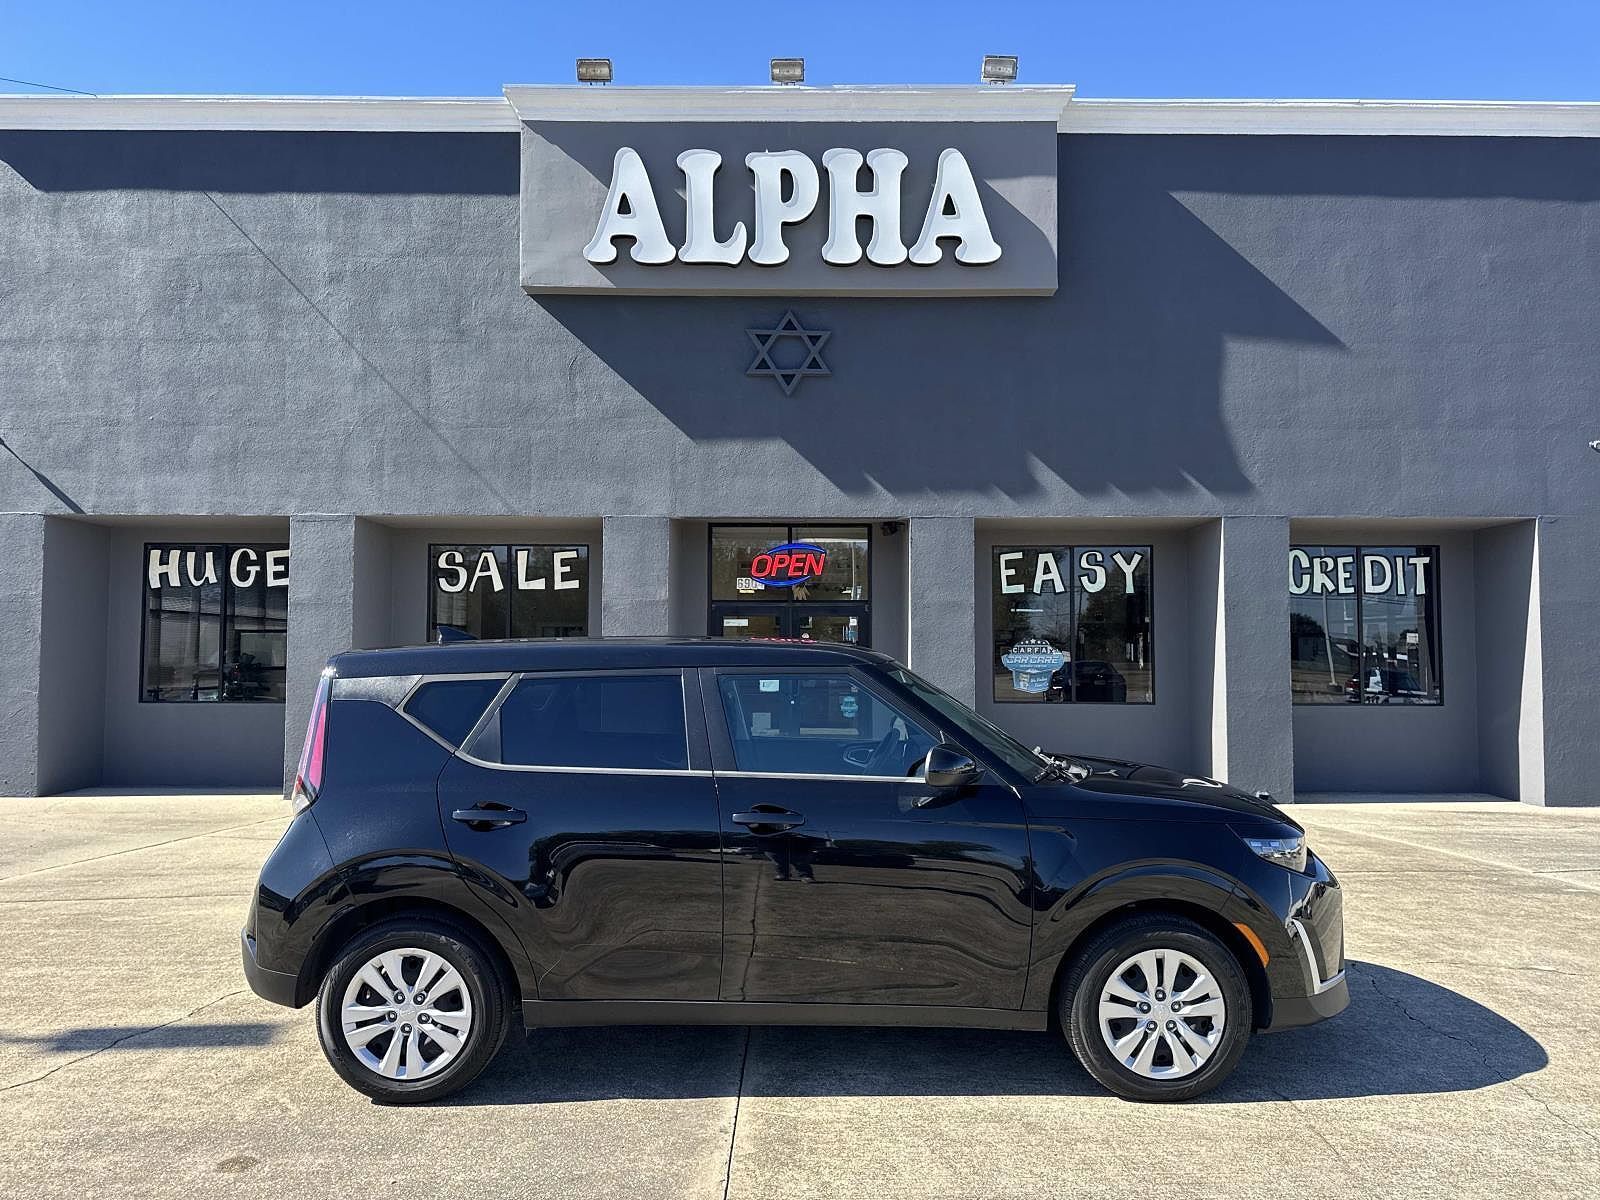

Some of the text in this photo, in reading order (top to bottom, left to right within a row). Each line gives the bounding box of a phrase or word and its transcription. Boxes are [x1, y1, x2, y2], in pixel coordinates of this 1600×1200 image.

[582, 147, 1002, 265] ALPHA
[148, 548, 580, 593] HUGE SALE
[751, 553, 826, 578] OPEN
[999, 549, 1431, 595] EASY CREDIT
[1006, 656, 1060, 664] CAR CARE
